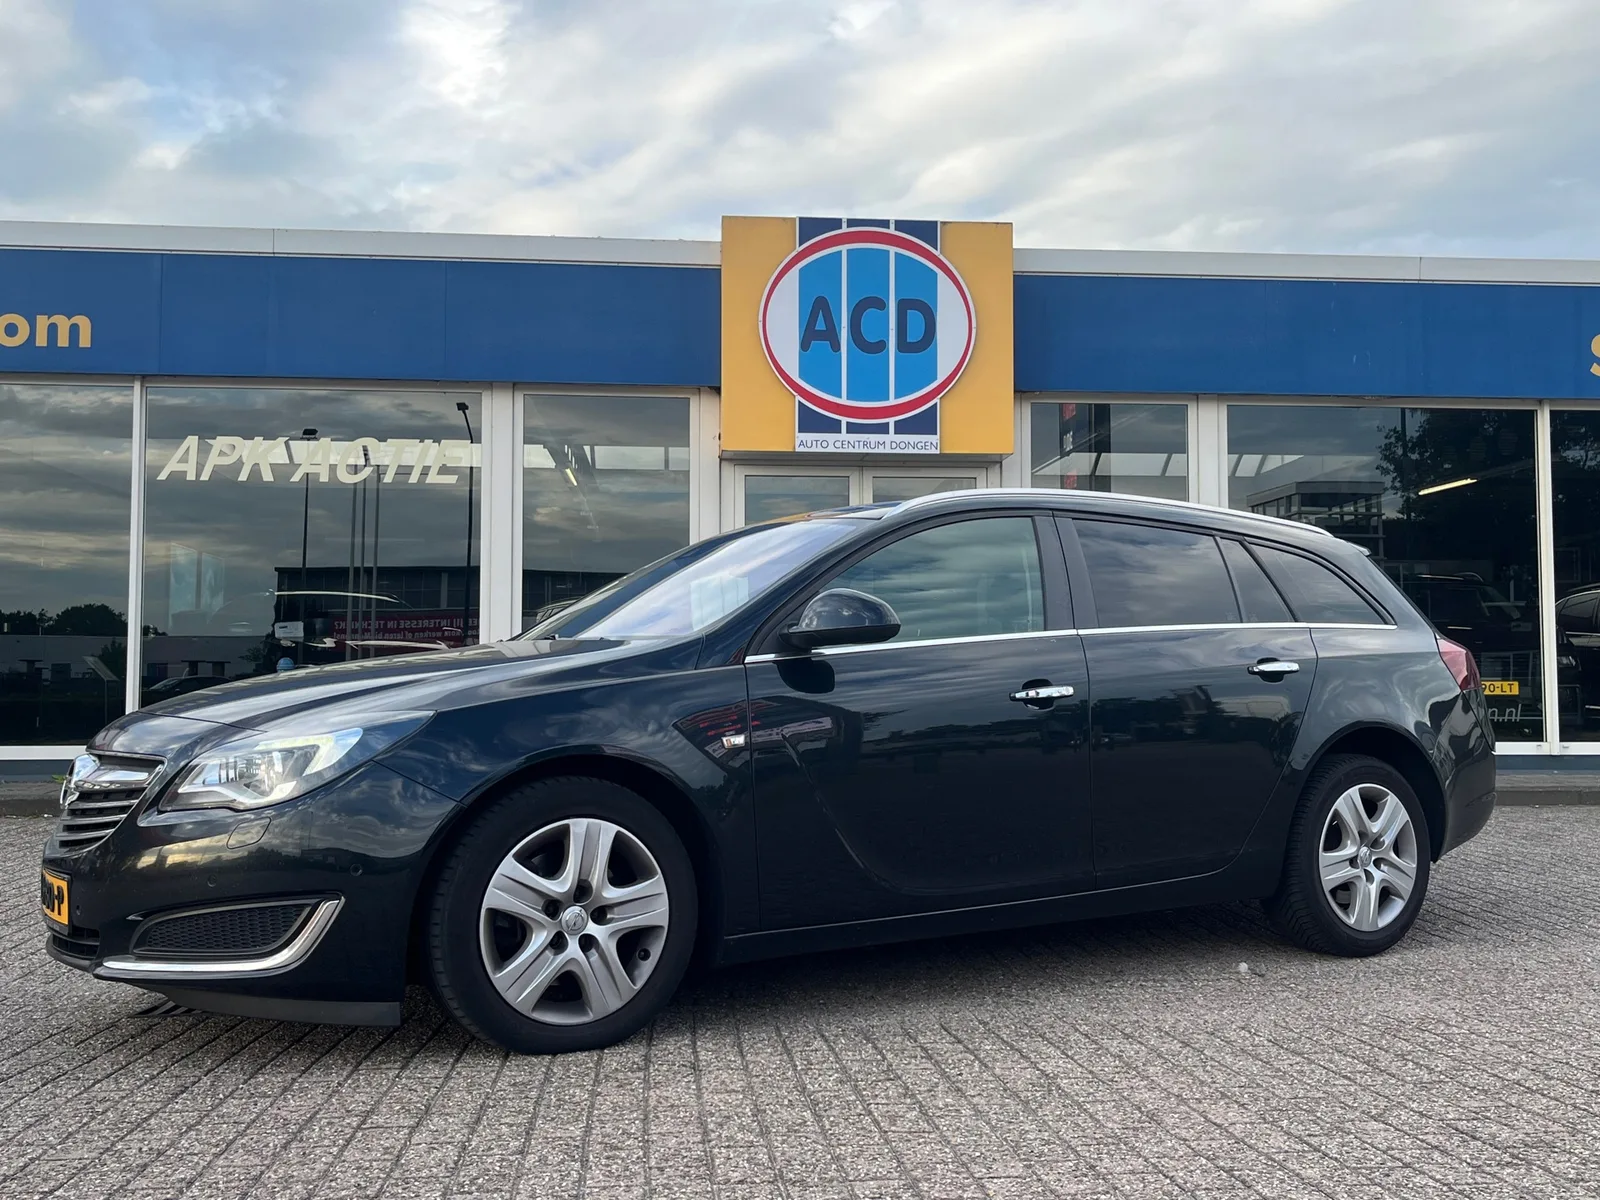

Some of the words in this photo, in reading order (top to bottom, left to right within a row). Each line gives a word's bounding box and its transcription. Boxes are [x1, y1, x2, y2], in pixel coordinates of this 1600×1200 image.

[800, 296, 937, 354] ACD
[156, 435, 290, 482] APK
[290, 437, 473, 484] ACTIE
[797, 439, 830, 450] AUTO
[833, 440, 886, 450] CENTRUM
[890, 441, 939, 451] DONGEN
